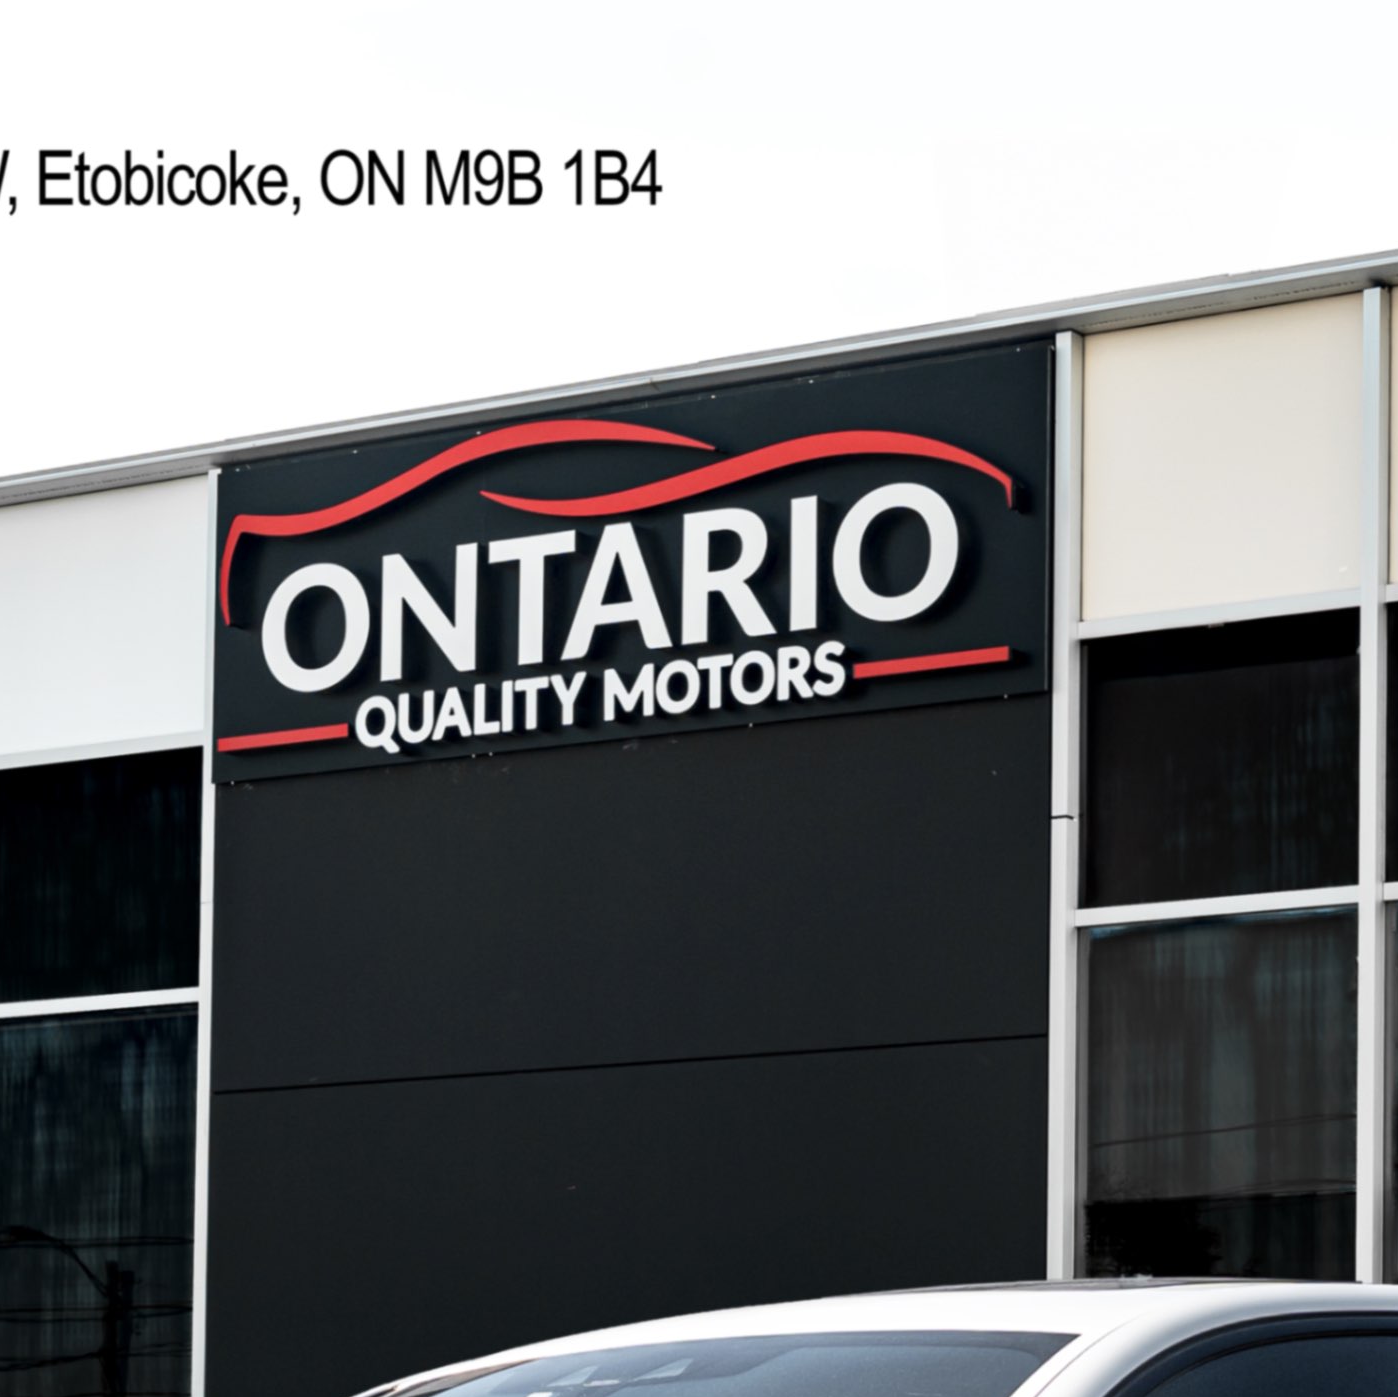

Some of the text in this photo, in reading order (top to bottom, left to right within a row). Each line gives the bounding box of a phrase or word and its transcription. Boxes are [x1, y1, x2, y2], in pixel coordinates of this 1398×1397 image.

[261, 482, 959, 693] ONTARIO
[355, 640, 846, 753] QUALITY MOTORS
